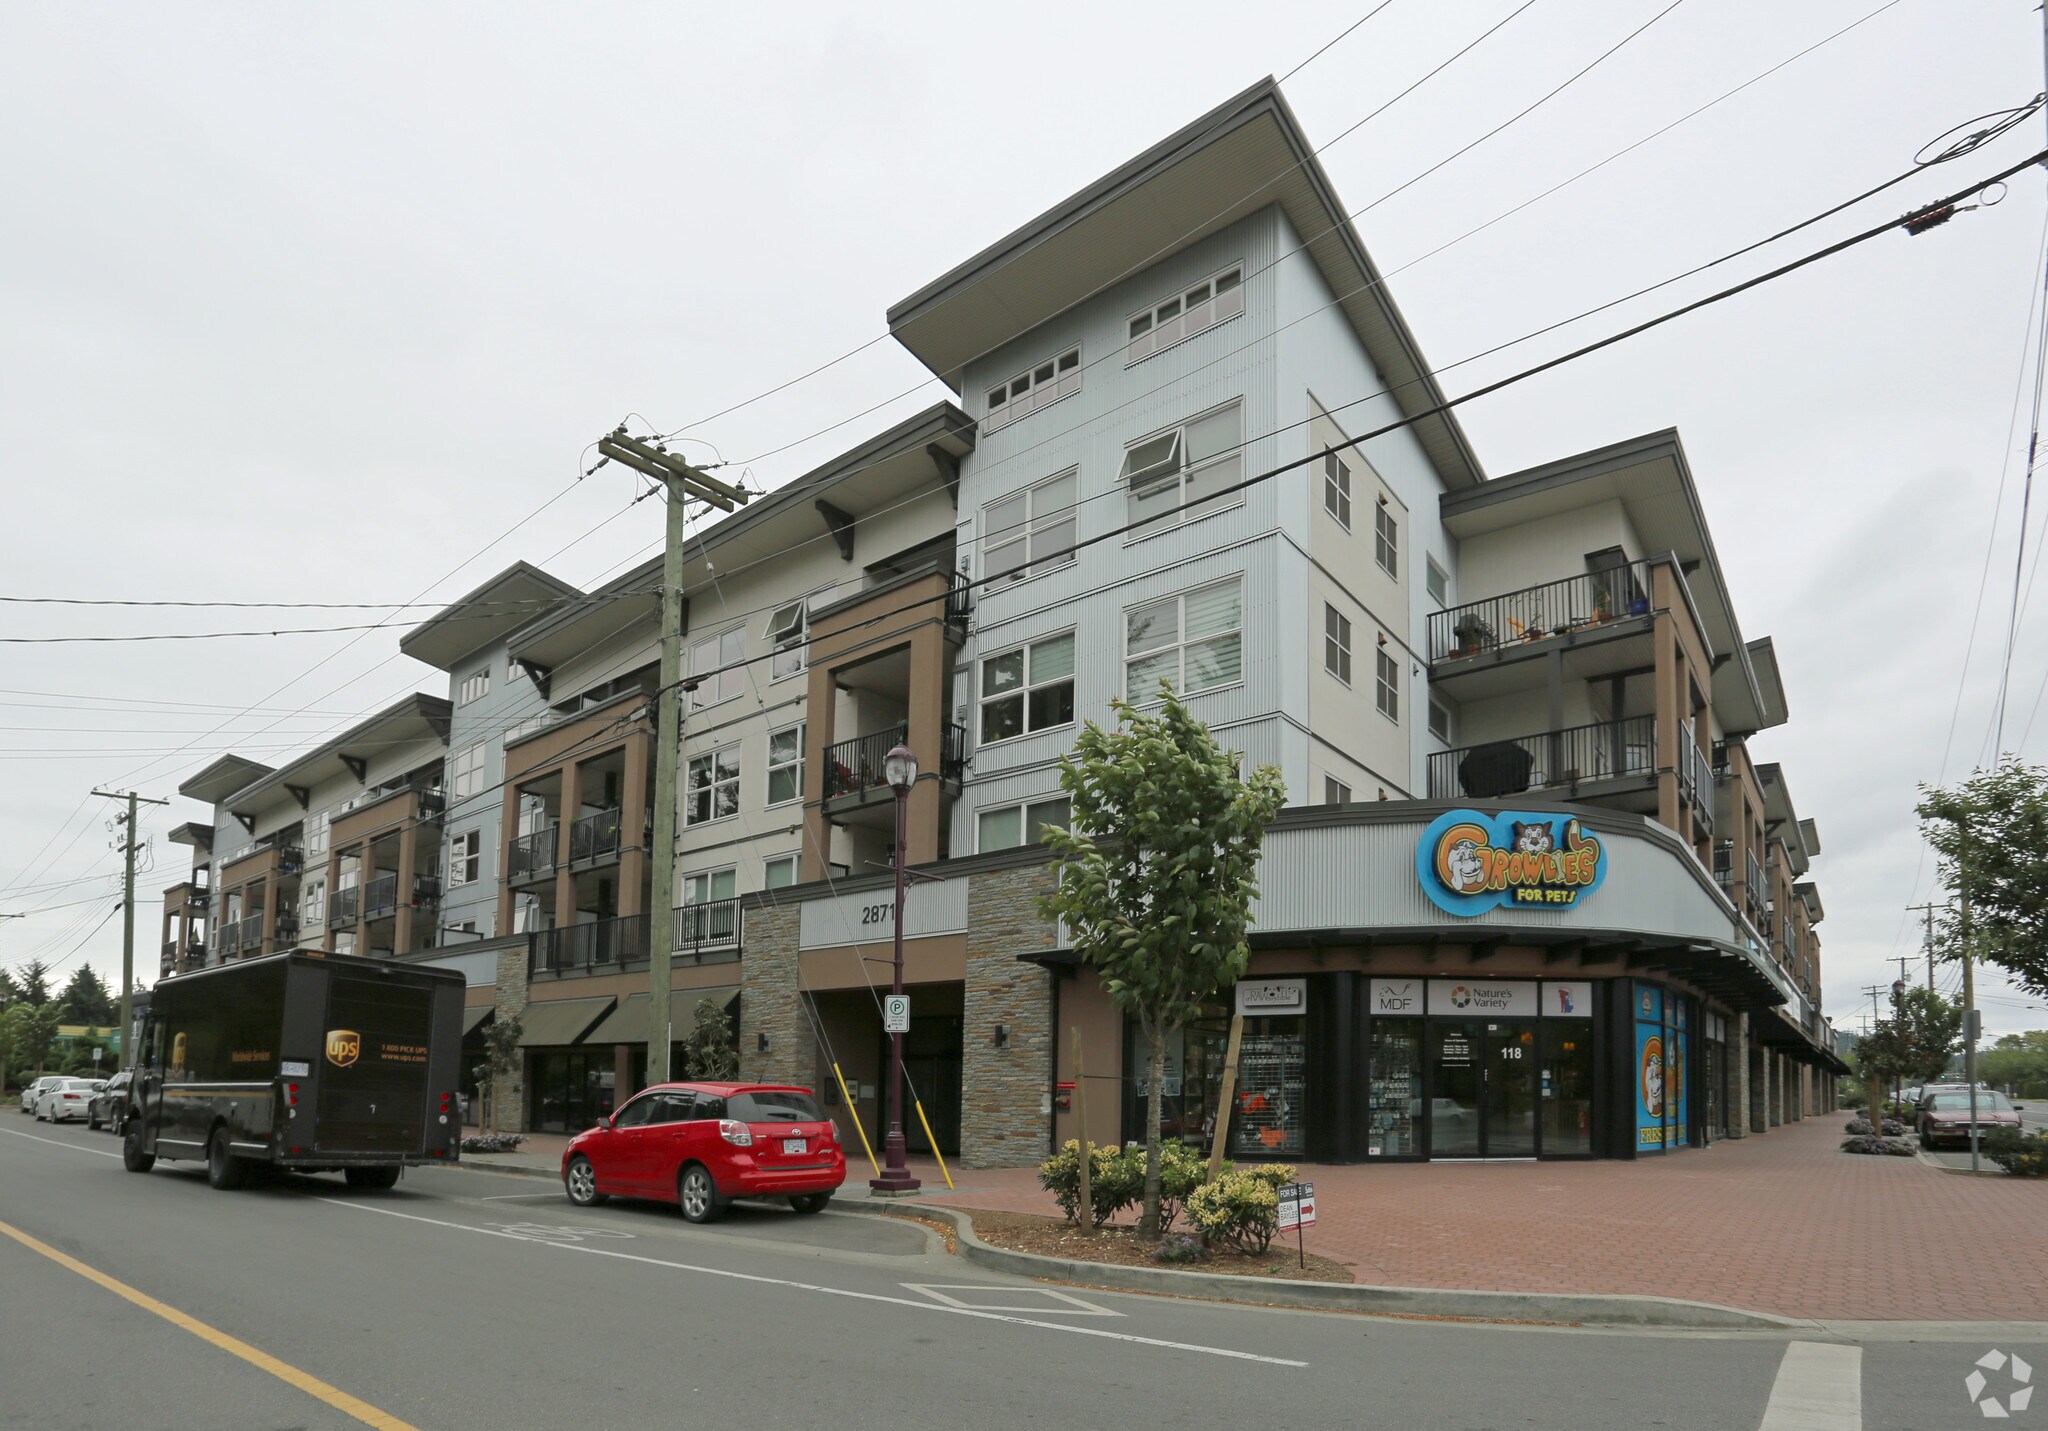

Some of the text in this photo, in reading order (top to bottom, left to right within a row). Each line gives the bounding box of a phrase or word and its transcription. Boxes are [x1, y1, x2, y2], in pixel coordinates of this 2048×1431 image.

[1517, 889, 1576, 902] FOR PETS
[862, 903, 895, 924] 2871
[1473, 988, 1512, 998] Nature's
[1380, 998, 1411, 1010] MDF
[1474, 998, 1508, 1009] Variety
[329, 1042, 357, 1061] ups
[381, 1053, 426, 1062] www.ups.com
[1501, 1047, 1522, 1059] 118
[1280, 1190, 1290, 1198] FOR
[1290, 1187, 1302, 1196] SAE
